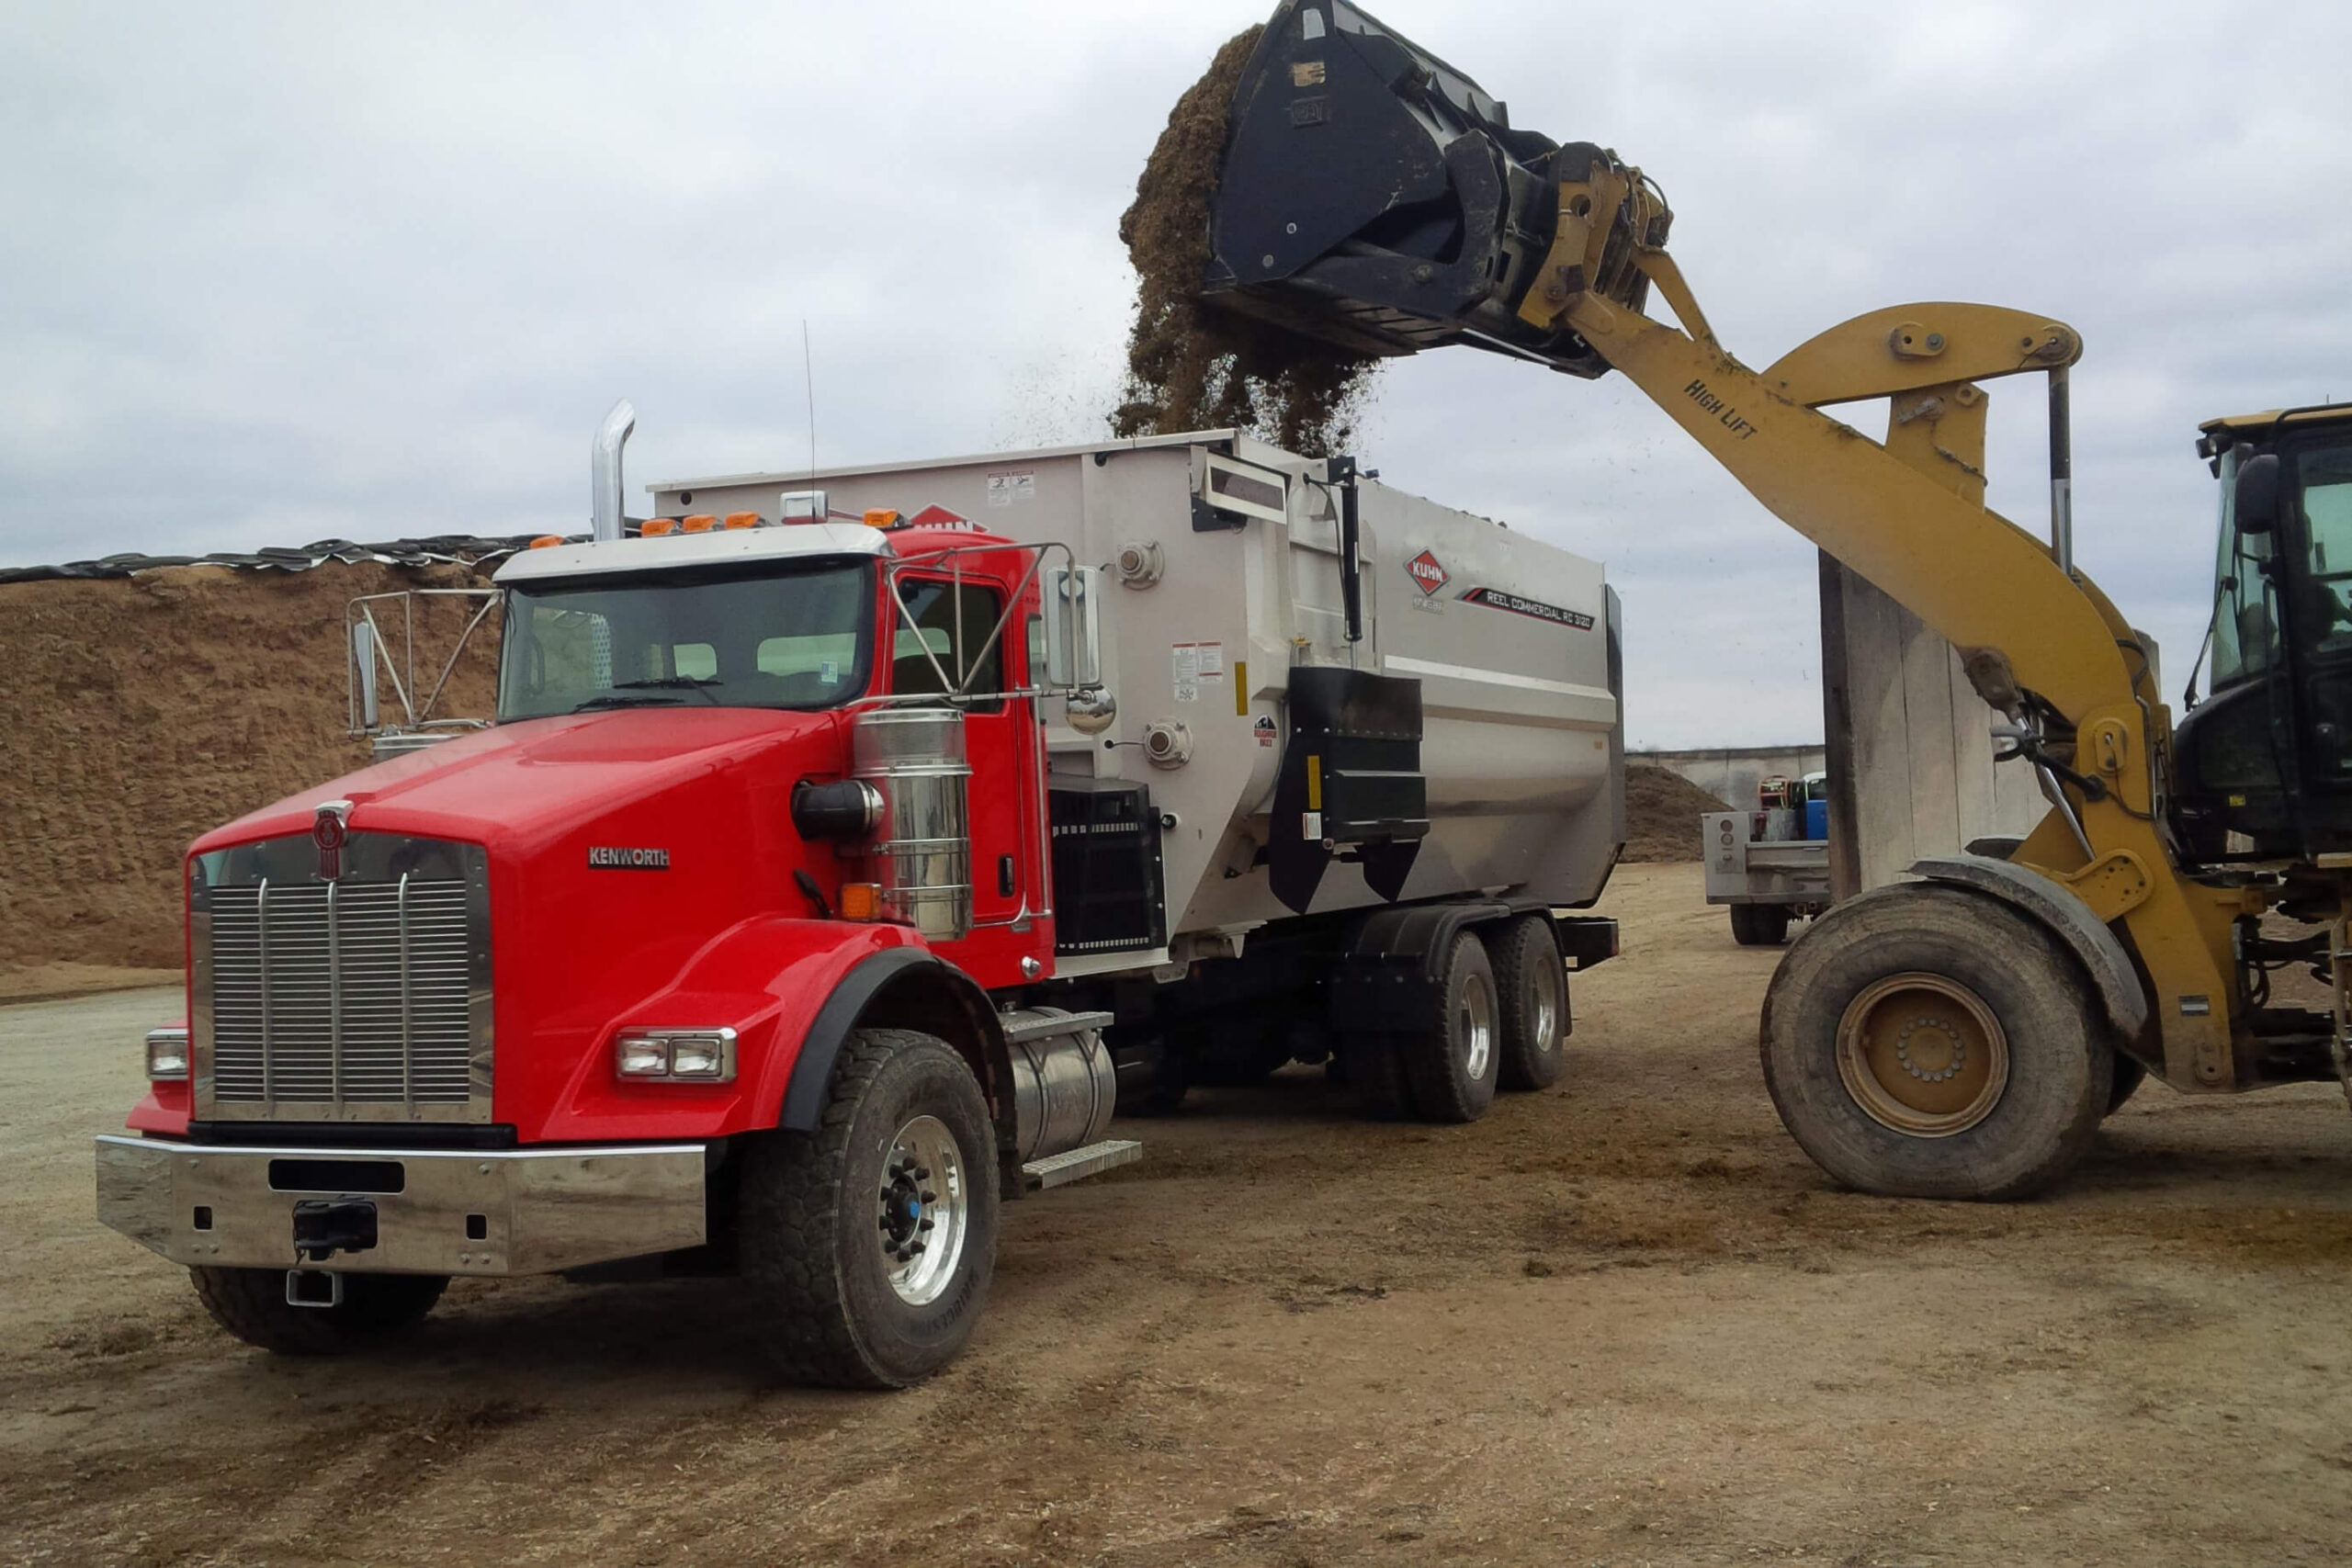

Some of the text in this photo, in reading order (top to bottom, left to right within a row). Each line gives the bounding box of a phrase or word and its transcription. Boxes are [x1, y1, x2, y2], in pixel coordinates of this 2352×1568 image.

[1683, 378, 1758, 440] HIGH LIFT
[1412, 560, 1443, 581] KUHN
[1487, 592, 1510, 607] REEL
[1511, 598, 1562, 620] COMMERCIAL
[1563, 612, 1573, 623] RC
[589, 847, 670, 865] KENWORTH
